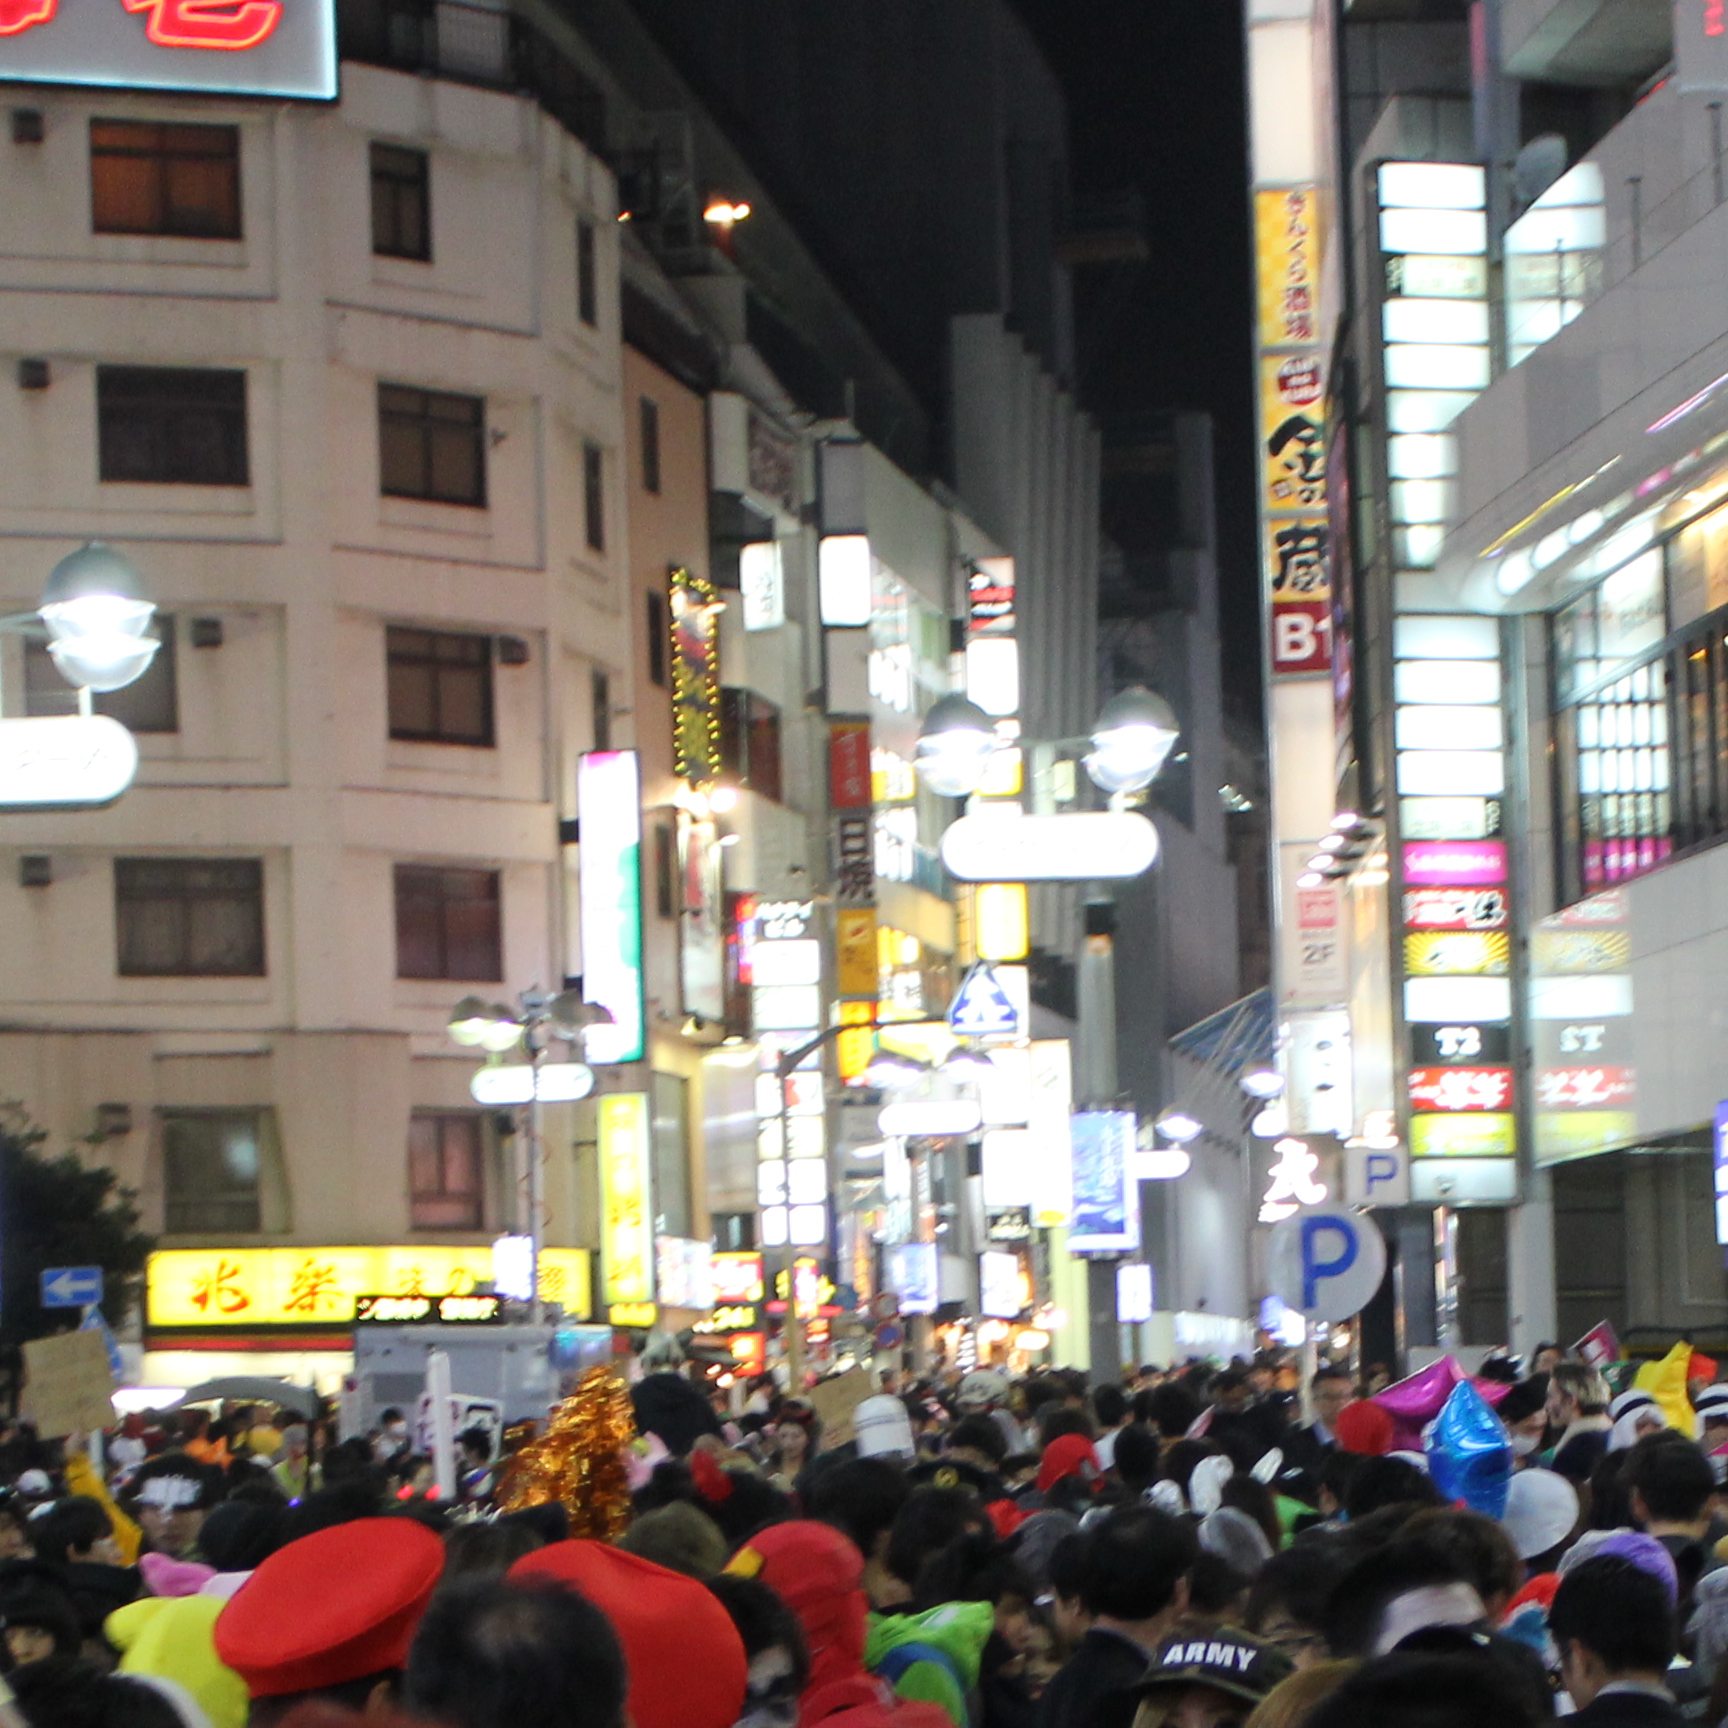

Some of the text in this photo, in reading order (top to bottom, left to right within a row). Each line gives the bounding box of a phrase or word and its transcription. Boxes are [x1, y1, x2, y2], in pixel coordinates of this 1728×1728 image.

[1365, 1154, 1399, 1196] P
[1299, 1214, 1360, 1310] P
[1161, 1640, 1259, 1673] ARMY
